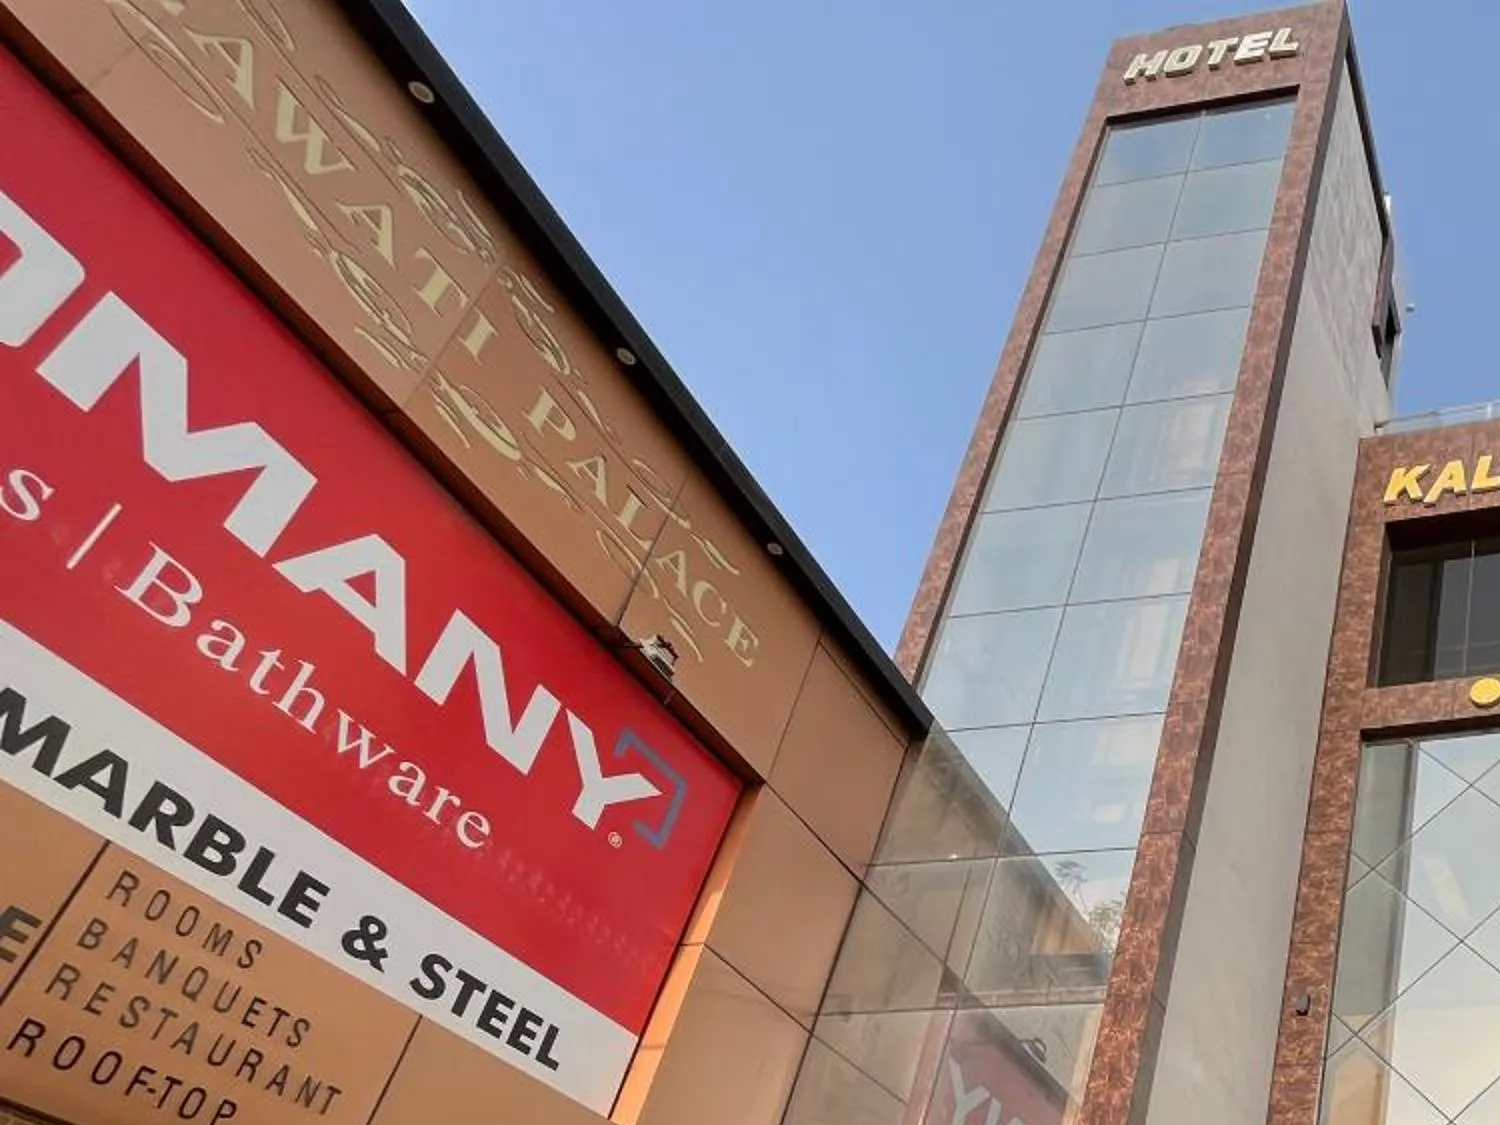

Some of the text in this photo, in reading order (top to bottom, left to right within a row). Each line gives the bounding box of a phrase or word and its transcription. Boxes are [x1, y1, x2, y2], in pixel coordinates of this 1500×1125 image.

[1123, 27, 1299, 86] HOTEL
[524, 387, 762, 668] PALACE
[114, 538, 493, 850] Bathware
[77, 917, 310, 1048] BANQUETS
[106, 870, 263, 969] ROOMS
[341, 915, 389, 973] &
[409, 953, 560, 1071] STEEL
[45, 963, 343, 1116] RESTAURANT
